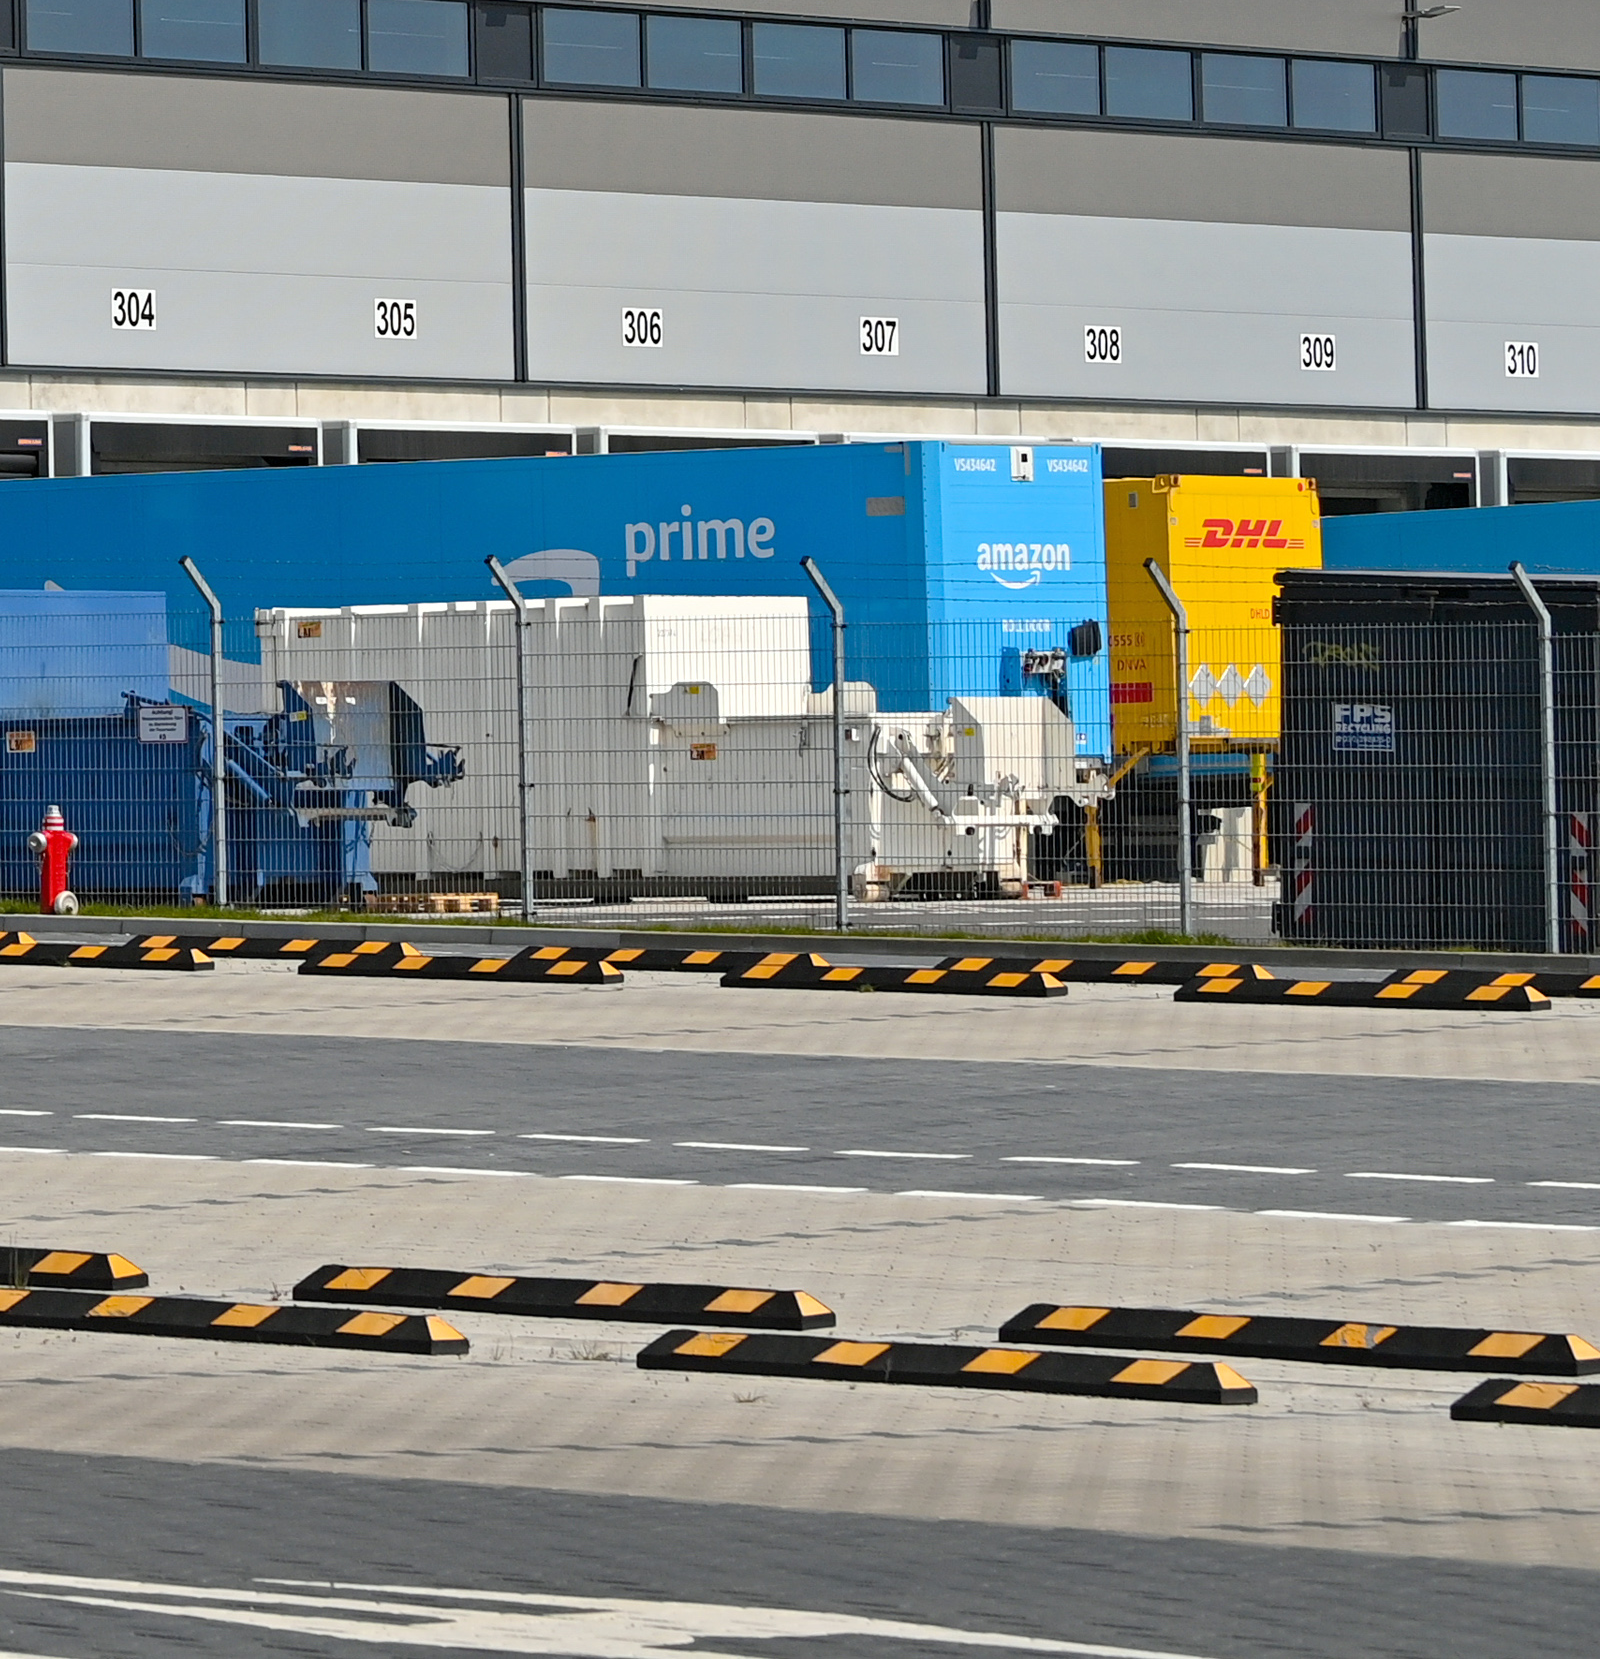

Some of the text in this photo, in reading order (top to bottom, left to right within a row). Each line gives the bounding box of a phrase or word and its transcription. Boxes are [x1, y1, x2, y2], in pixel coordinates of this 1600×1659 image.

[113, 291, 154, 327] 304
[376, 301, 415, 337] 305
[624, 310, 662, 345] 306
[862, 319, 897, 353] 307
[1086, 328, 1120, 361] 308
[1302, 336, 1334, 369] 309
[1507, 344, 1537, 375] 310
[954, 458, 997, 472] VS434642
[1046, 459, 1088, 473] VS434642
[625, 504, 776, 577] prime
[1201, 519, 1289, 548] DHL
[976, 543, 1071, 570] amazon
[1334, 704, 1391, 722] FPS
[1335, 723, 1391, 734] RECYCLING
